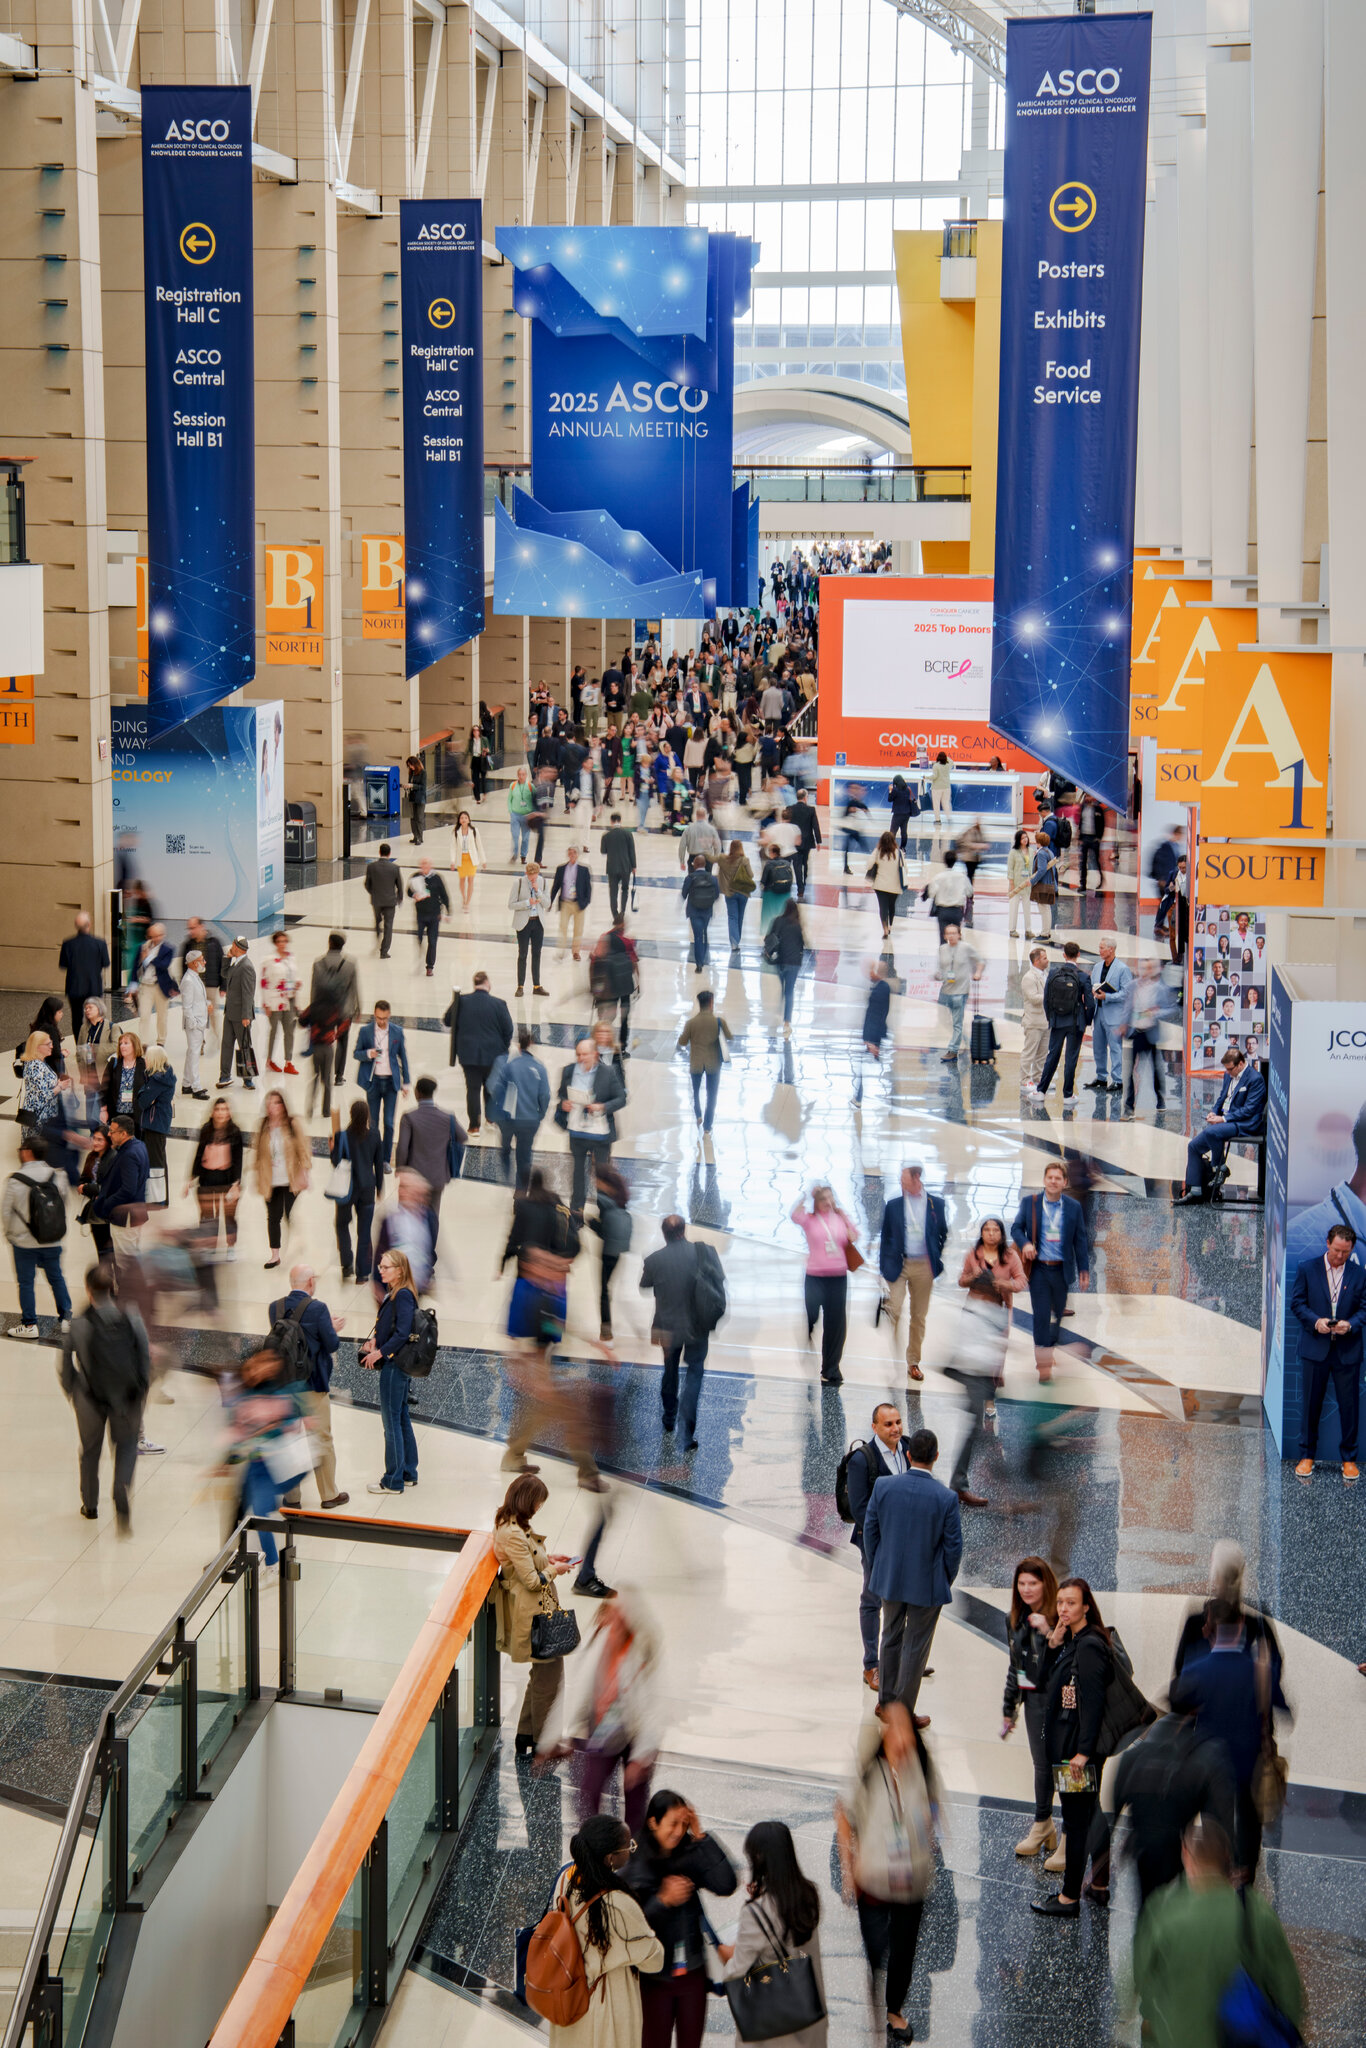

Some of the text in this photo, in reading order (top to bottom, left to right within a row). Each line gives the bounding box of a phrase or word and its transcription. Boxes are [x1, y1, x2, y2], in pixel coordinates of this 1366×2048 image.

[1036, 68, 1120, 97] ASCO
[1078, 97, 1103, 105] CLINICAL
[1104, 96, 1136, 104] ONCOLOGY
[1016, 108, 1062, 116] KNOWLEDGE
[1064, 106, 1104, 114] CONQUERS
[165, 119, 229, 141] ASCO
[417, 223, 466, 240] ASCO
[1038, 260, 1105, 278] Posters
[156, 286, 241, 306] Registration
[177, 307, 220, 323] Hall C
[1034, 309, 1106, 329] Exhibits
[175, 349, 222, 365] ASCO
[410, 345, 474, 359] Registration
[426, 359, 459, 371] Hall C
[1045, 359, 1091, 379] Food
[173, 369, 225, 385] Central
[425, 390, 460, 401] ASCO
[548, 380, 709, 413] 2025 ASCO
[1033, 385, 1102, 404] Service
[423, 404, 463, 417] Central
[173, 411, 226, 427] Session
[548, 421, 709, 438] ANNUAL MEETING
[176, 431, 222, 447] Hall B1
[423, 435, 463, 447] Session
[426, 449, 461, 461] Hall B1
[790, 532, 846, 540] CENTER
[914, 623, 992, 635] 2025 Top Donors
[269, 640, 320, 653] NORTH
[924, 660, 959, 673] BCRF
[118, 737, 151, 750] WAY.
[878, 732, 1018, 750] CONQUER CANCE
[1204, 854, 1318, 881] SOUTH
[1327, 1030, 1366, 1051] JCO
